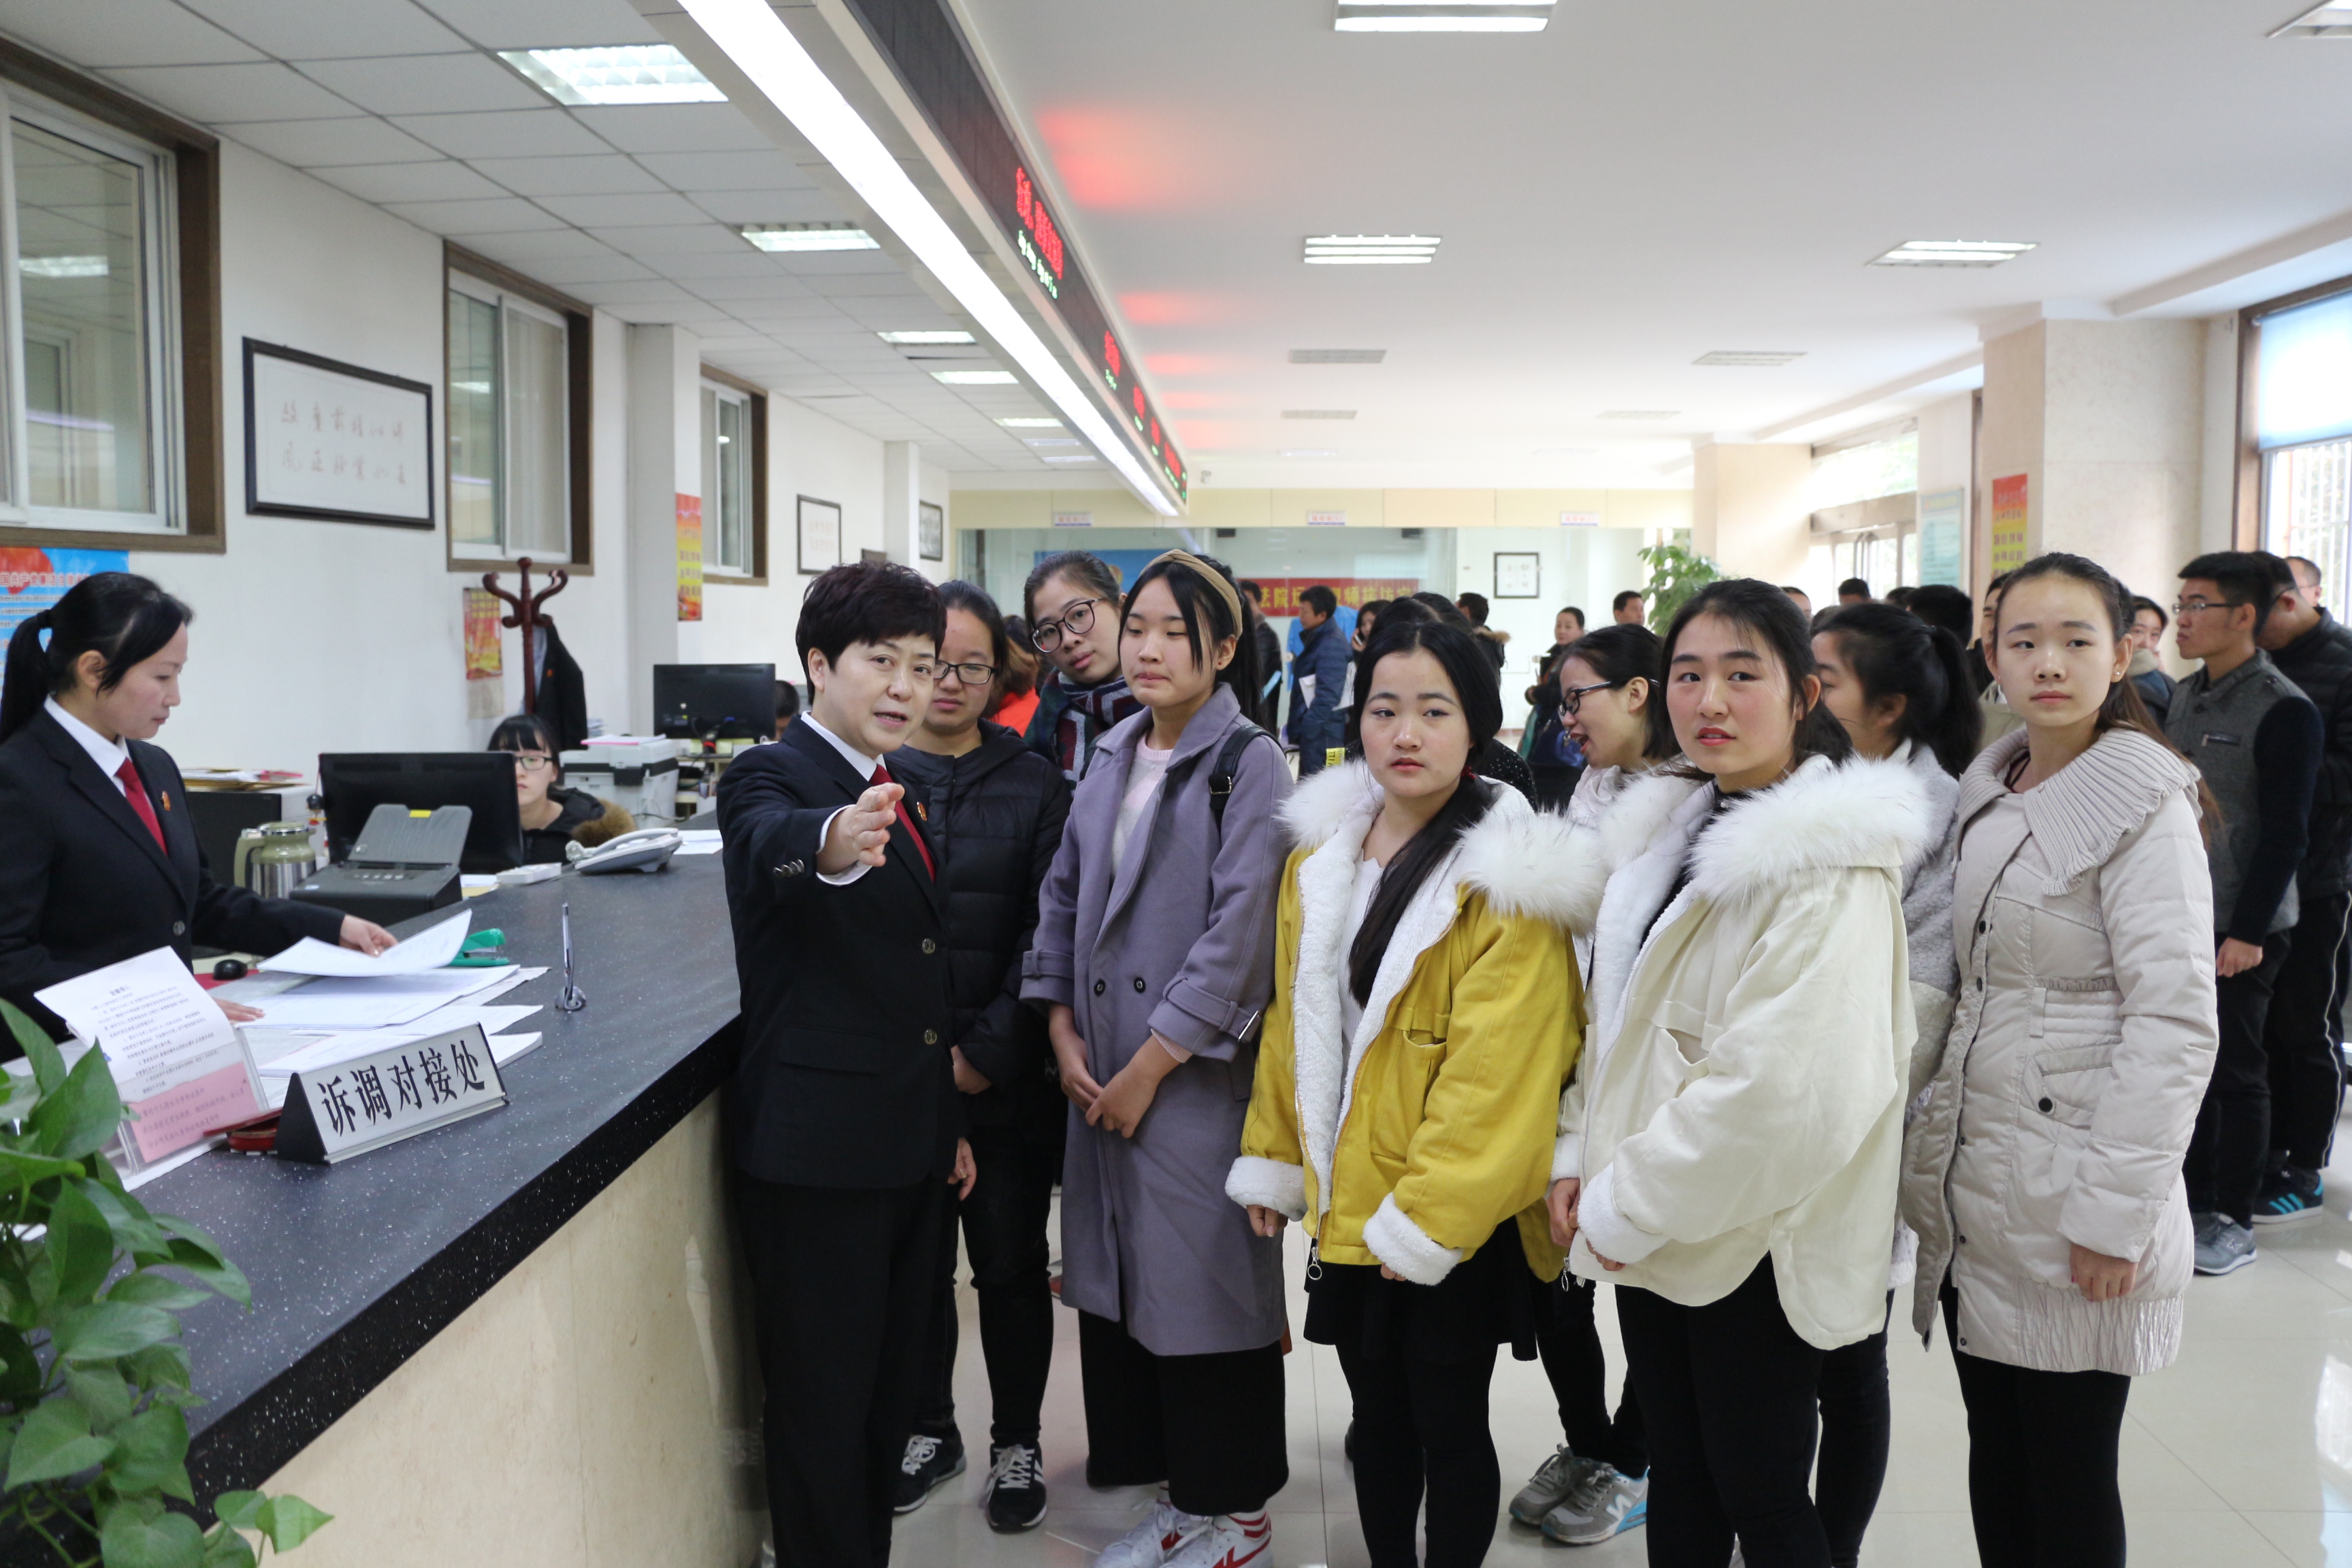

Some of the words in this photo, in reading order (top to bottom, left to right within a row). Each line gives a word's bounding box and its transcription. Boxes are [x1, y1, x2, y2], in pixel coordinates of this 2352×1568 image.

[1260, 586, 1412, 608] 法院远频接访
[317, 1040, 485, 1137] 诉调对接处
